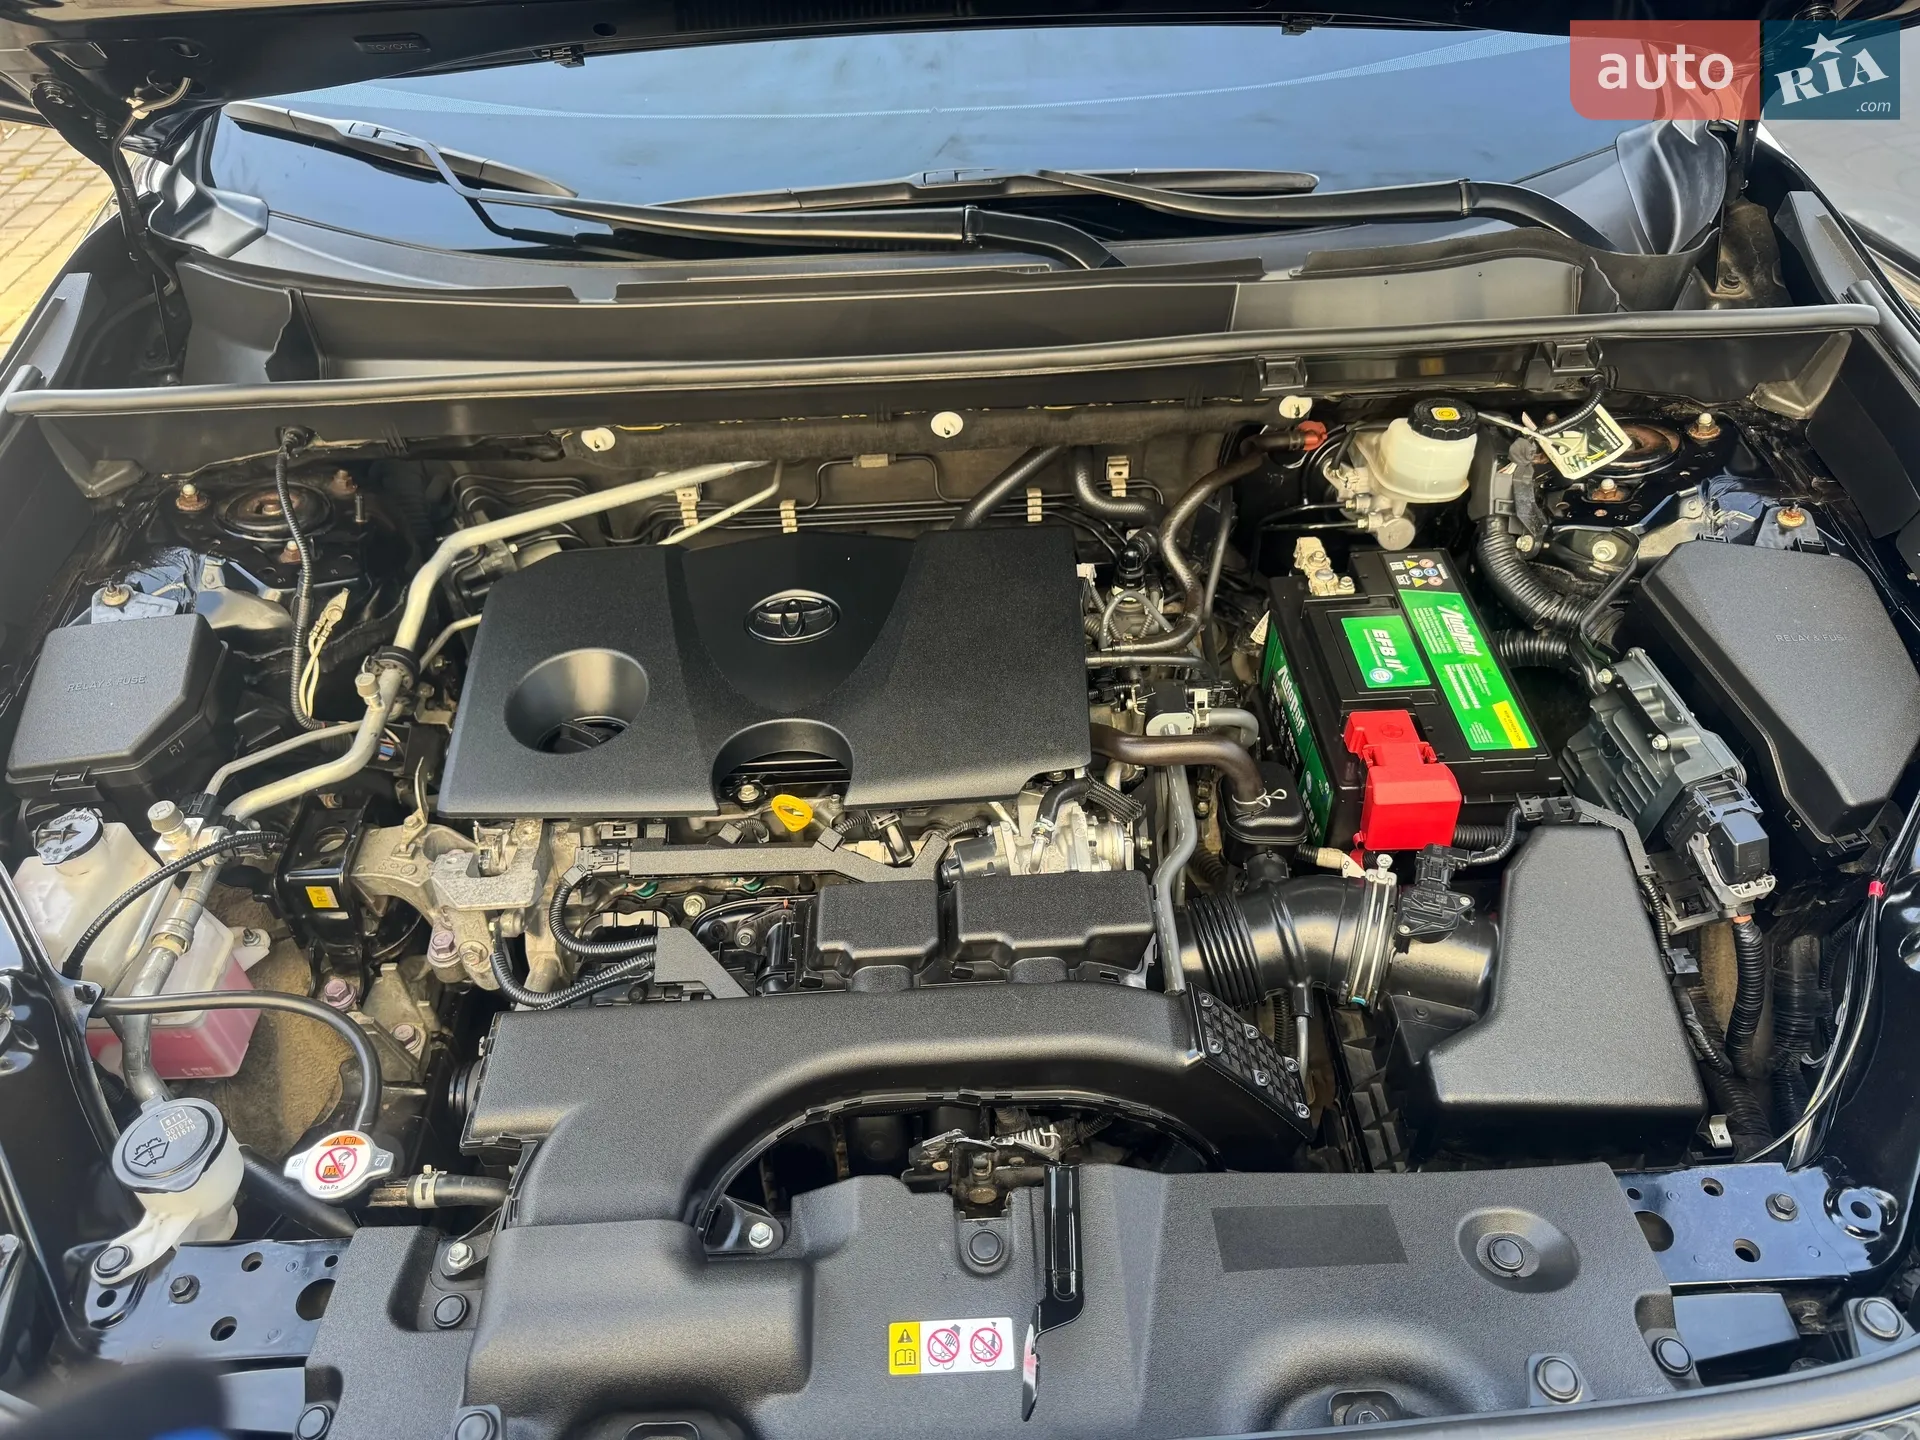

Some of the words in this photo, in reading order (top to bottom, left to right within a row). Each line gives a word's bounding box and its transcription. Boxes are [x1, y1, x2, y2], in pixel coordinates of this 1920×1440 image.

[367, 42, 419, 51] TOYOTA
[1371, 628, 1398, 657] EFB
[1774, 634, 1810, 642] RELAY
[67, 679, 105, 692] RELAY
[117, 675, 147, 686] FUSE
[53, 811, 94, 826] COOLANT
[1784, 809, 1802, 832] L2
